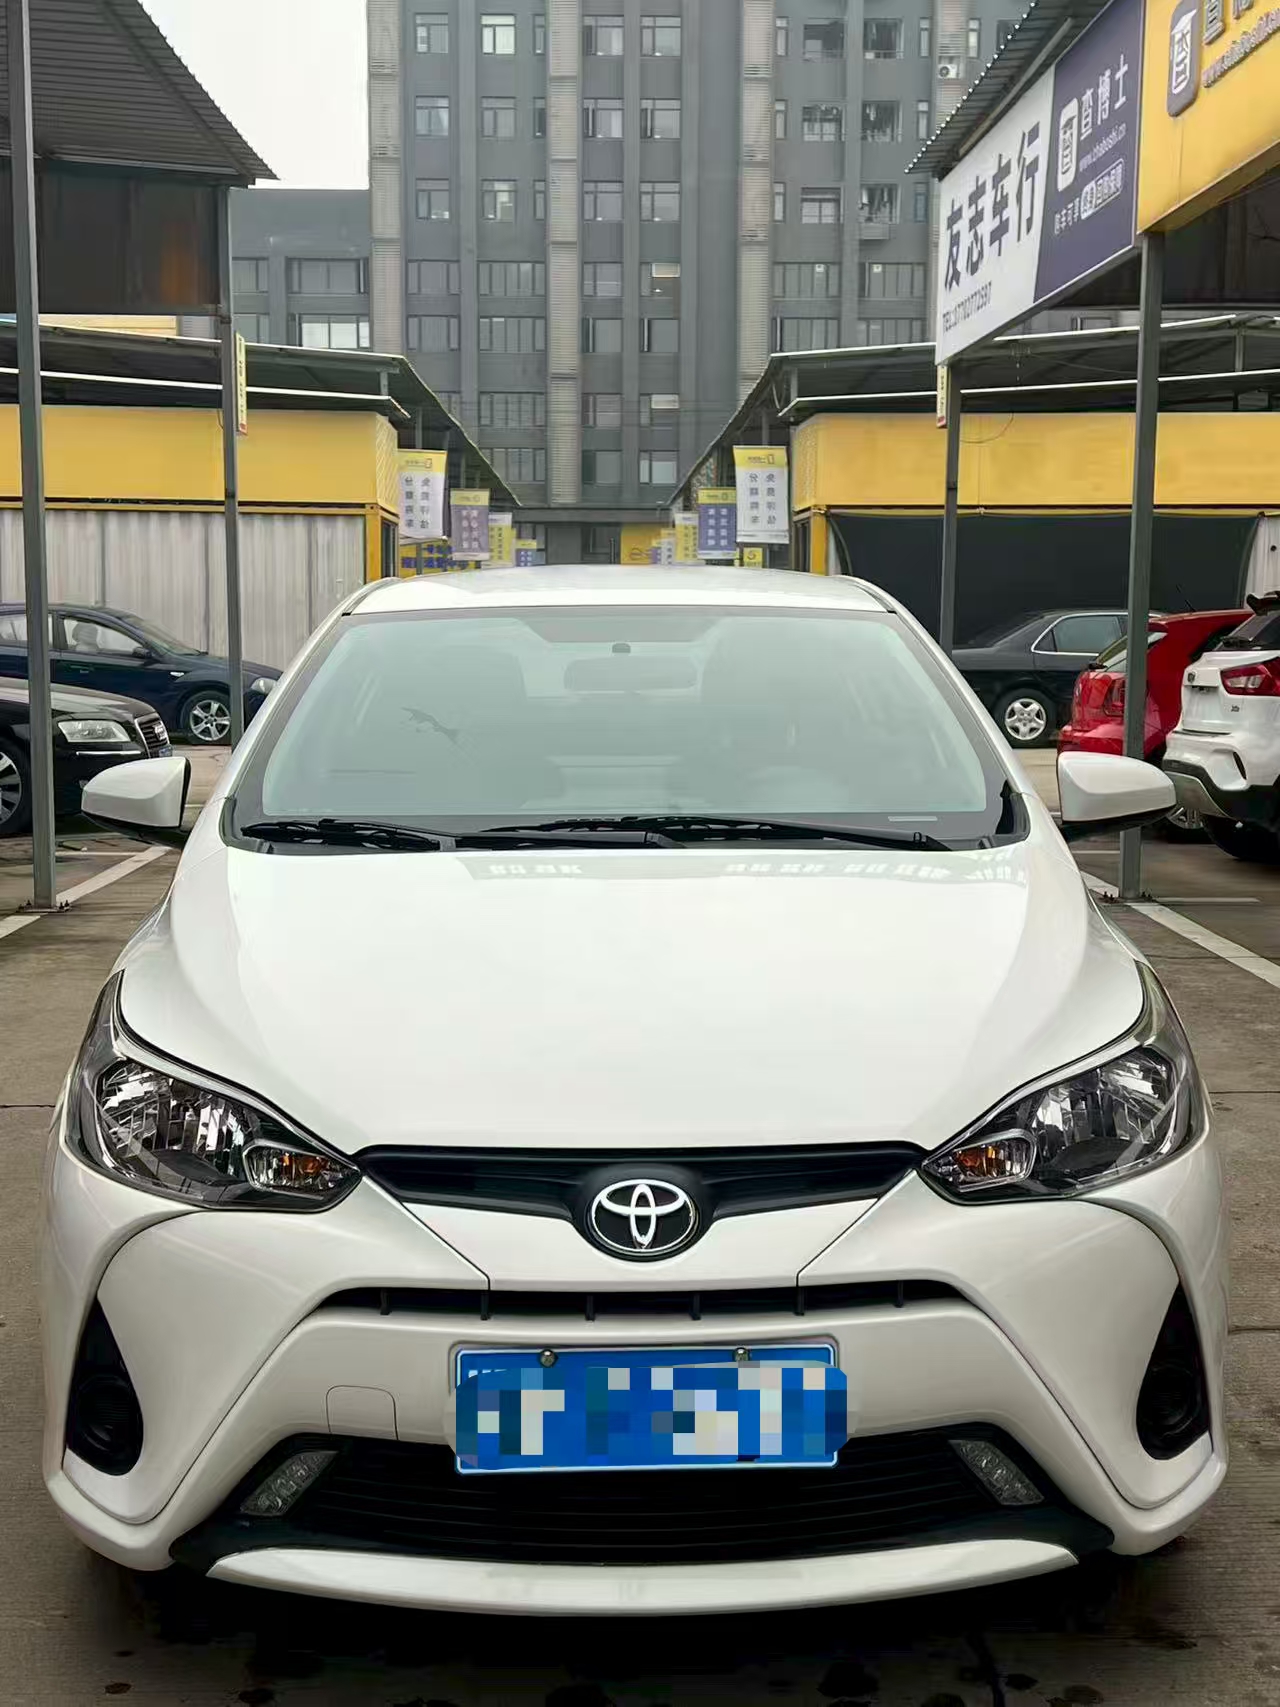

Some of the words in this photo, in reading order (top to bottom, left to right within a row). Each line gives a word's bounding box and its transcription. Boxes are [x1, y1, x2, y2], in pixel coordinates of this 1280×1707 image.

[1080, 54, 1129, 141] 查博士
[944, 121, 1040, 291] 友志车行
